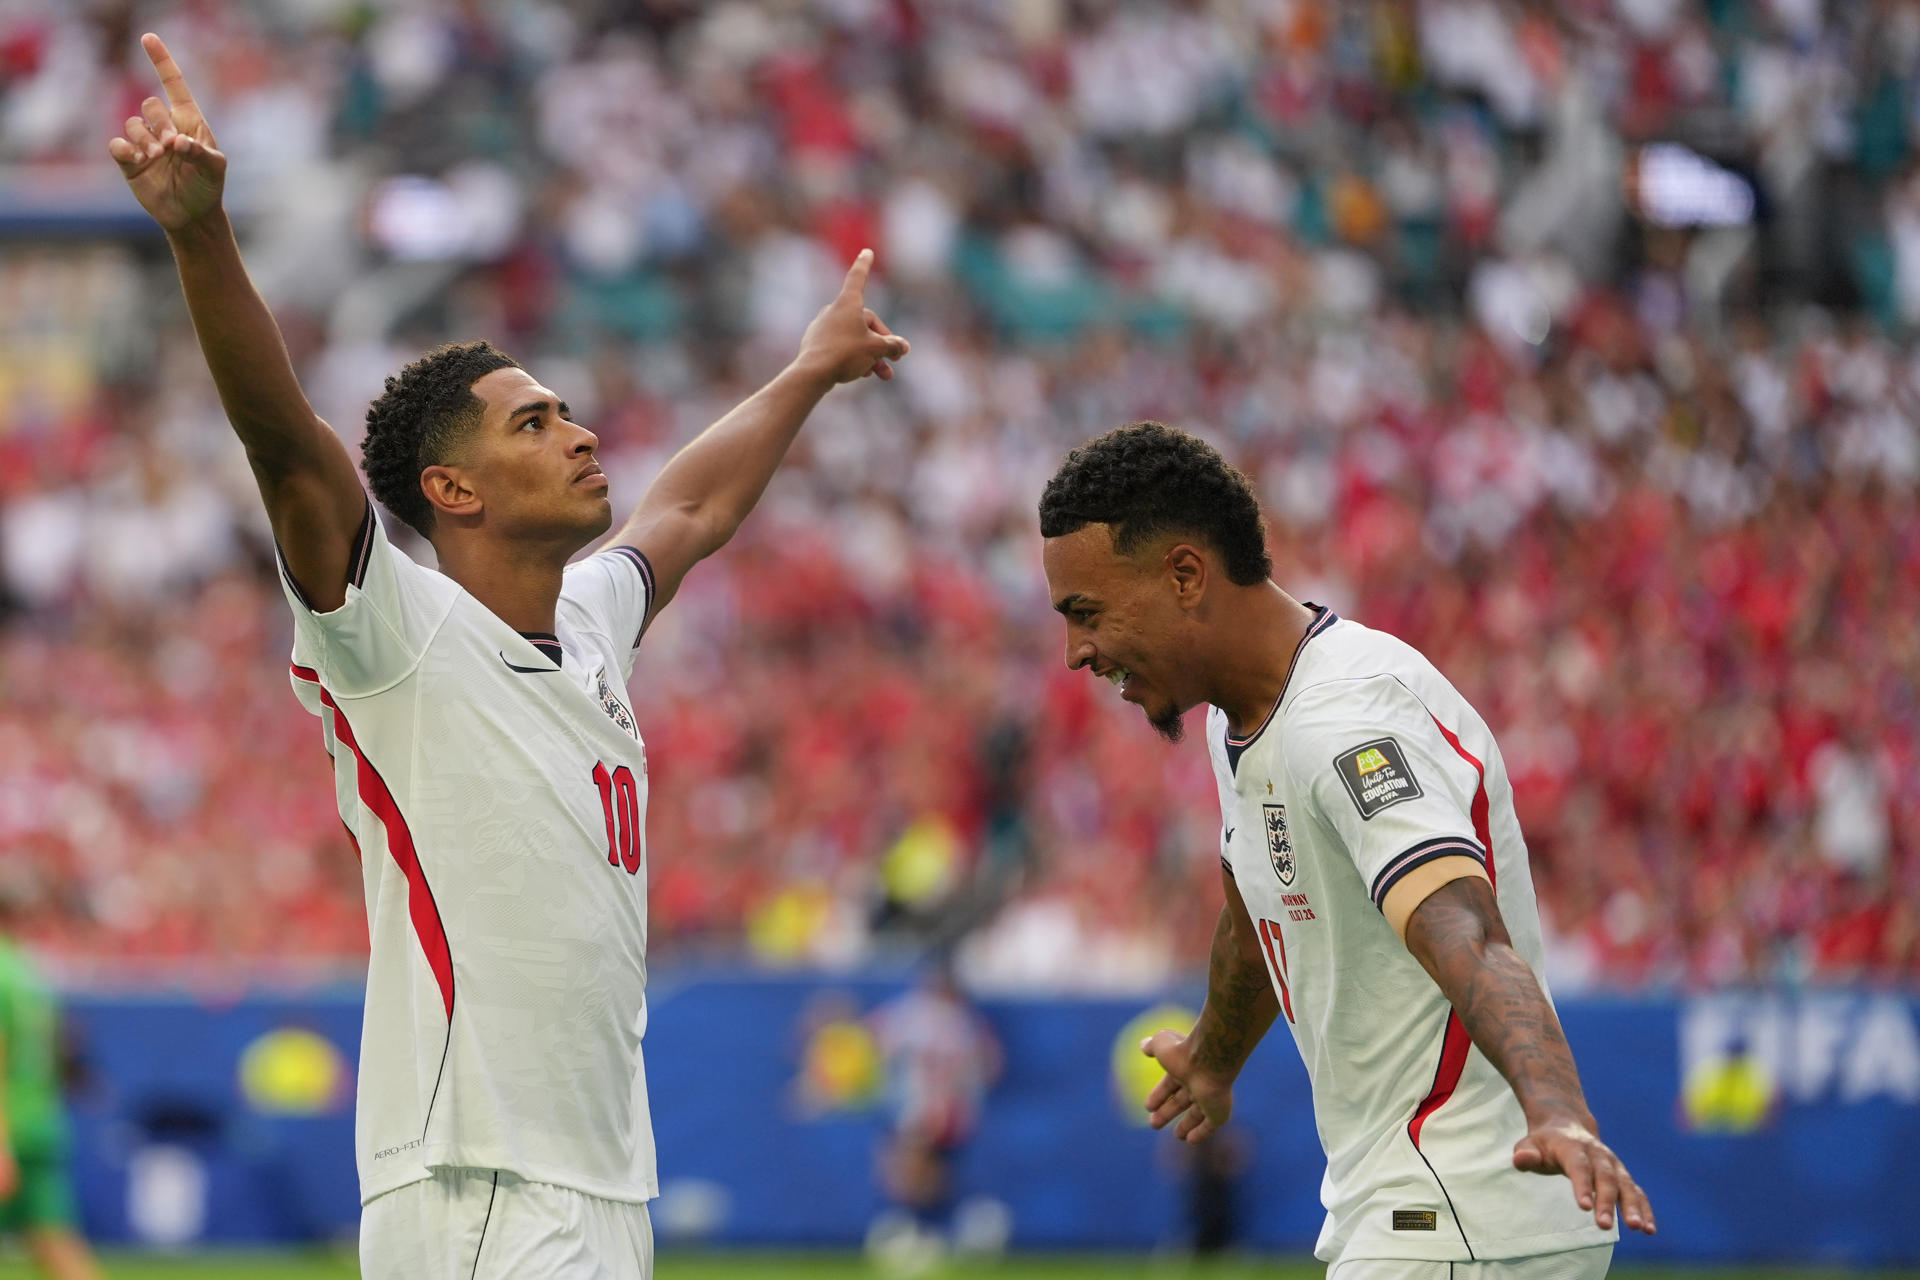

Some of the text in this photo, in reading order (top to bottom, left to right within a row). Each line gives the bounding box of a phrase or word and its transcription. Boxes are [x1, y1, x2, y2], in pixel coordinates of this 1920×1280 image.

[1362, 766, 1396, 789] Unite For
[1362, 778, 1409, 803] EDUCATION
[1380, 791, 1399, 803] FIFA
[592, 760, 641, 875] 10
[1281, 893, 1309, 906] NORWAY
[1259, 918, 1296, 1024] 17
[374, 1138, 422, 1160] AERO-FIT
